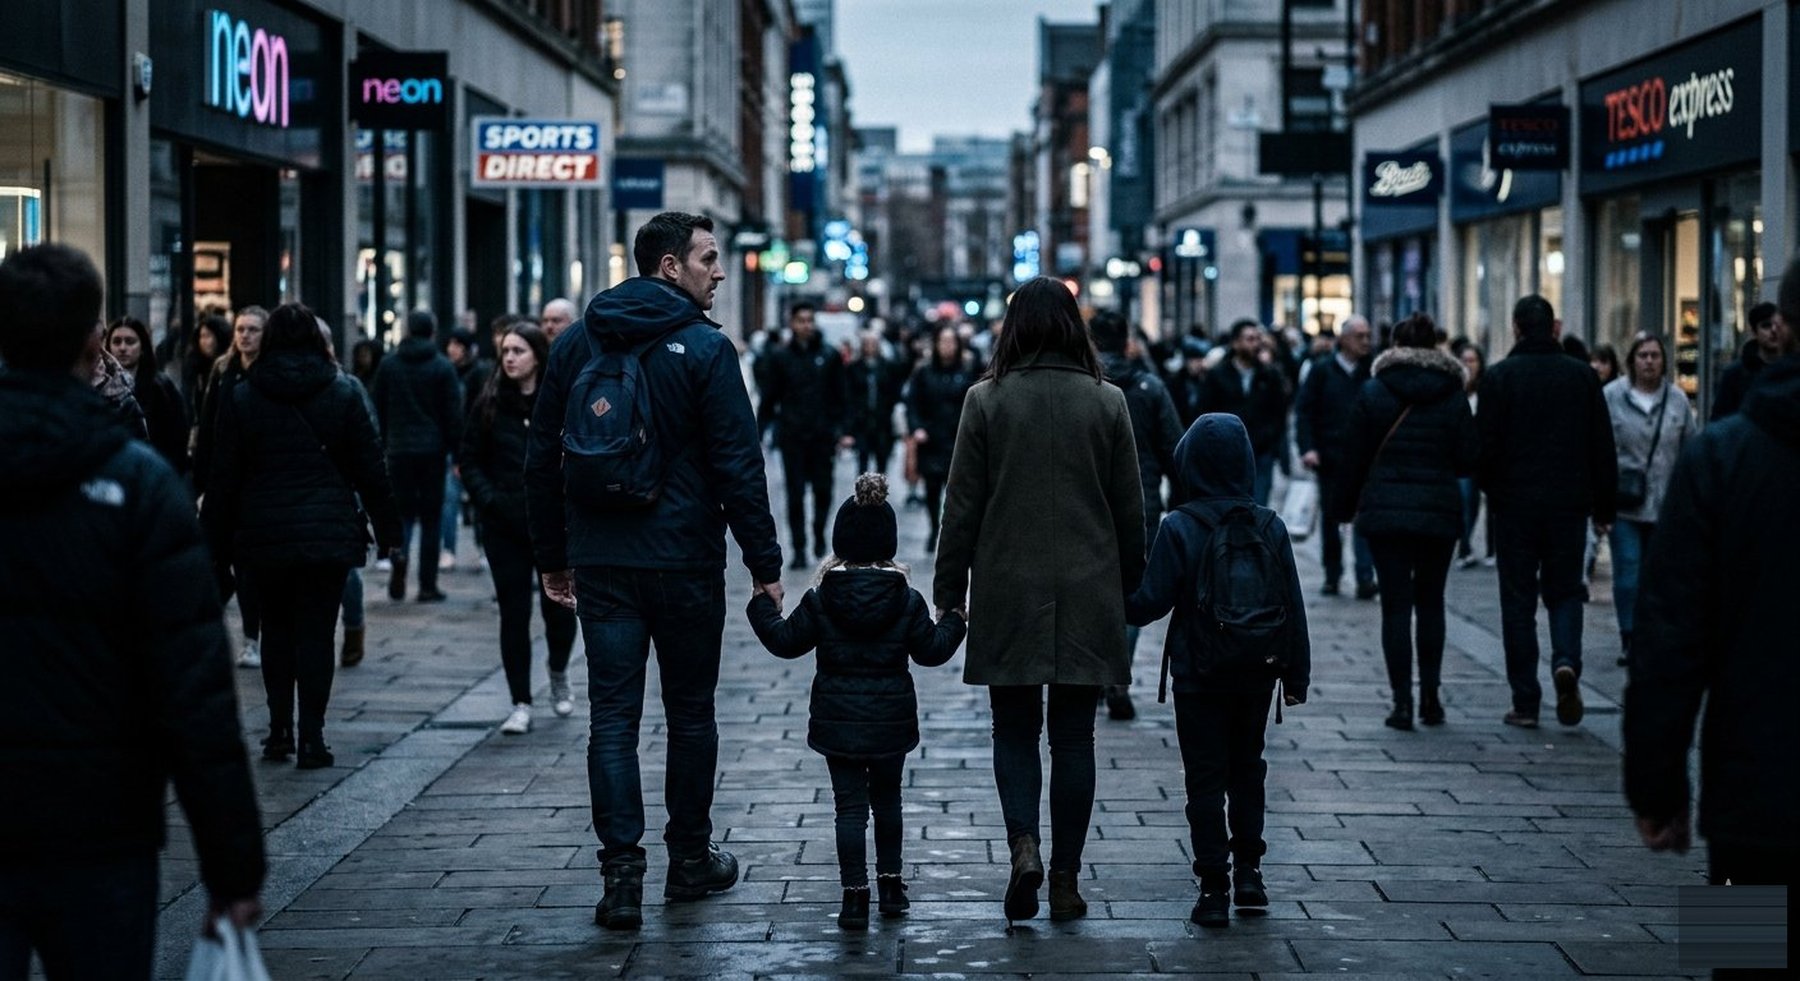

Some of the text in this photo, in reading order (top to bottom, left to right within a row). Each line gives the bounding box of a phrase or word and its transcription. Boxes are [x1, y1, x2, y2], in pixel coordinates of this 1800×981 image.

[210, 9, 289, 128] neon
[362, 77, 443, 104] neon
[1604, 66, 1735, 143] TESCO express
[485, 124, 594, 150] SPORTS
[484, 154, 594, 180] DIRECT
